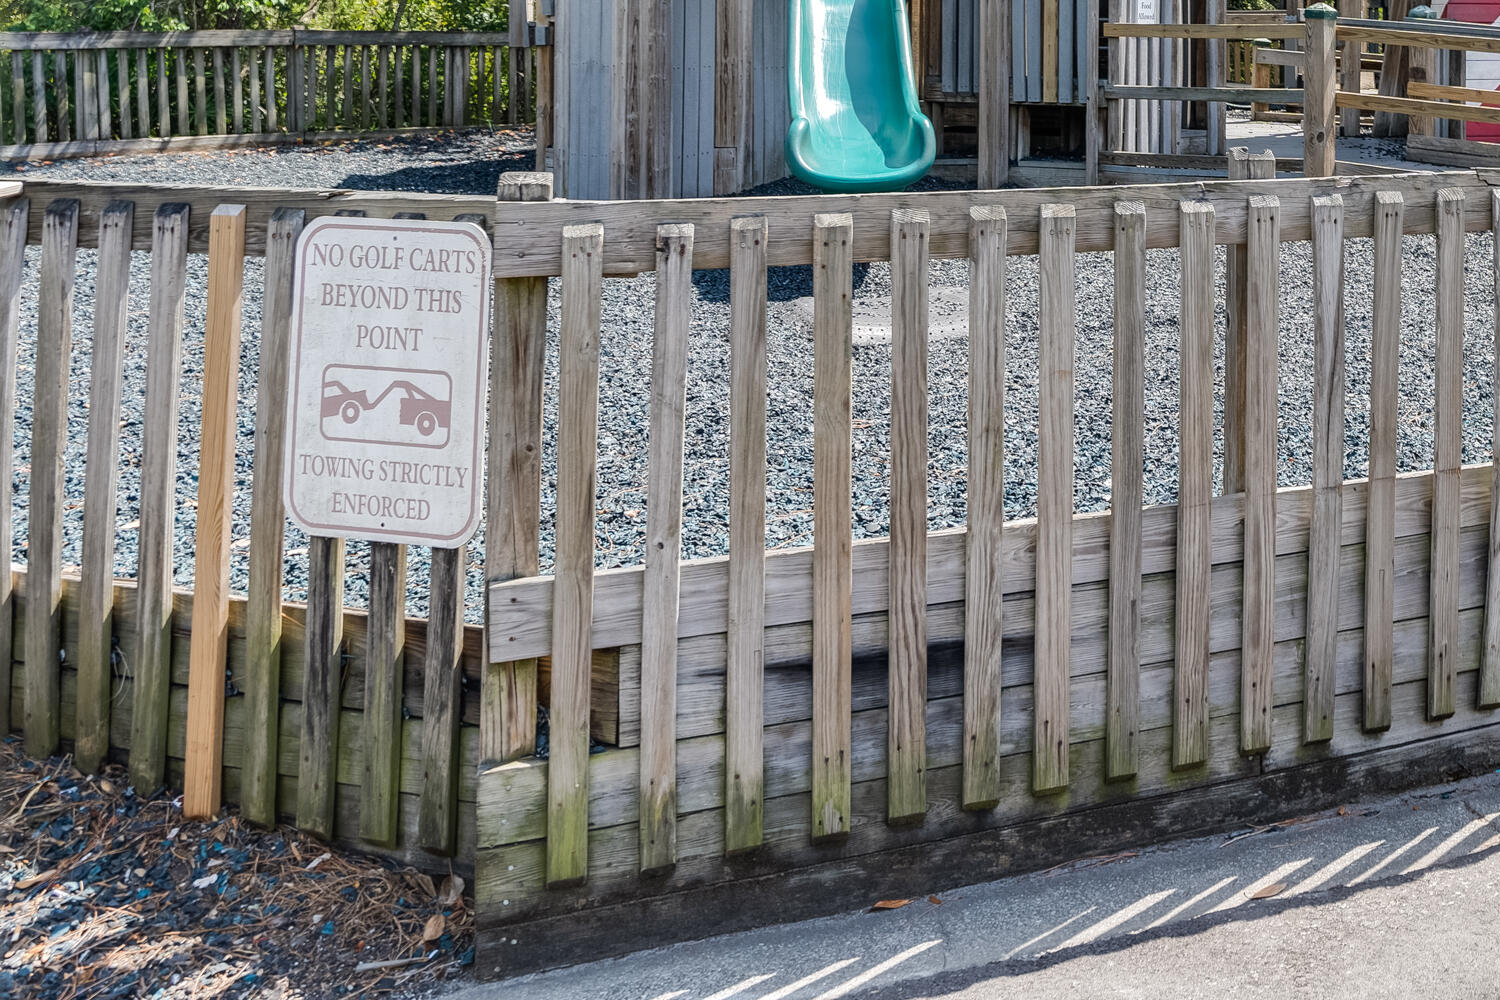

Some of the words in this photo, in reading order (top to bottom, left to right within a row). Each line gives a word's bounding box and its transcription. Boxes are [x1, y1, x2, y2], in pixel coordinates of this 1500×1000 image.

[1138, 12, 1155, 20] Allowed
[311, 243, 344, 267] NO
[349, 245, 405, 271] GOLF
[409, 248, 476, 274] CARTS
[321, 283, 409, 311] BEYOND
[415, 288, 463, 314] THIS
[356, 324, 424, 352] POINT
[300, 454, 374, 480] TOWING
[379, 459, 469, 489] STRICTLY
[331, 492, 431, 521] ENFORCED
